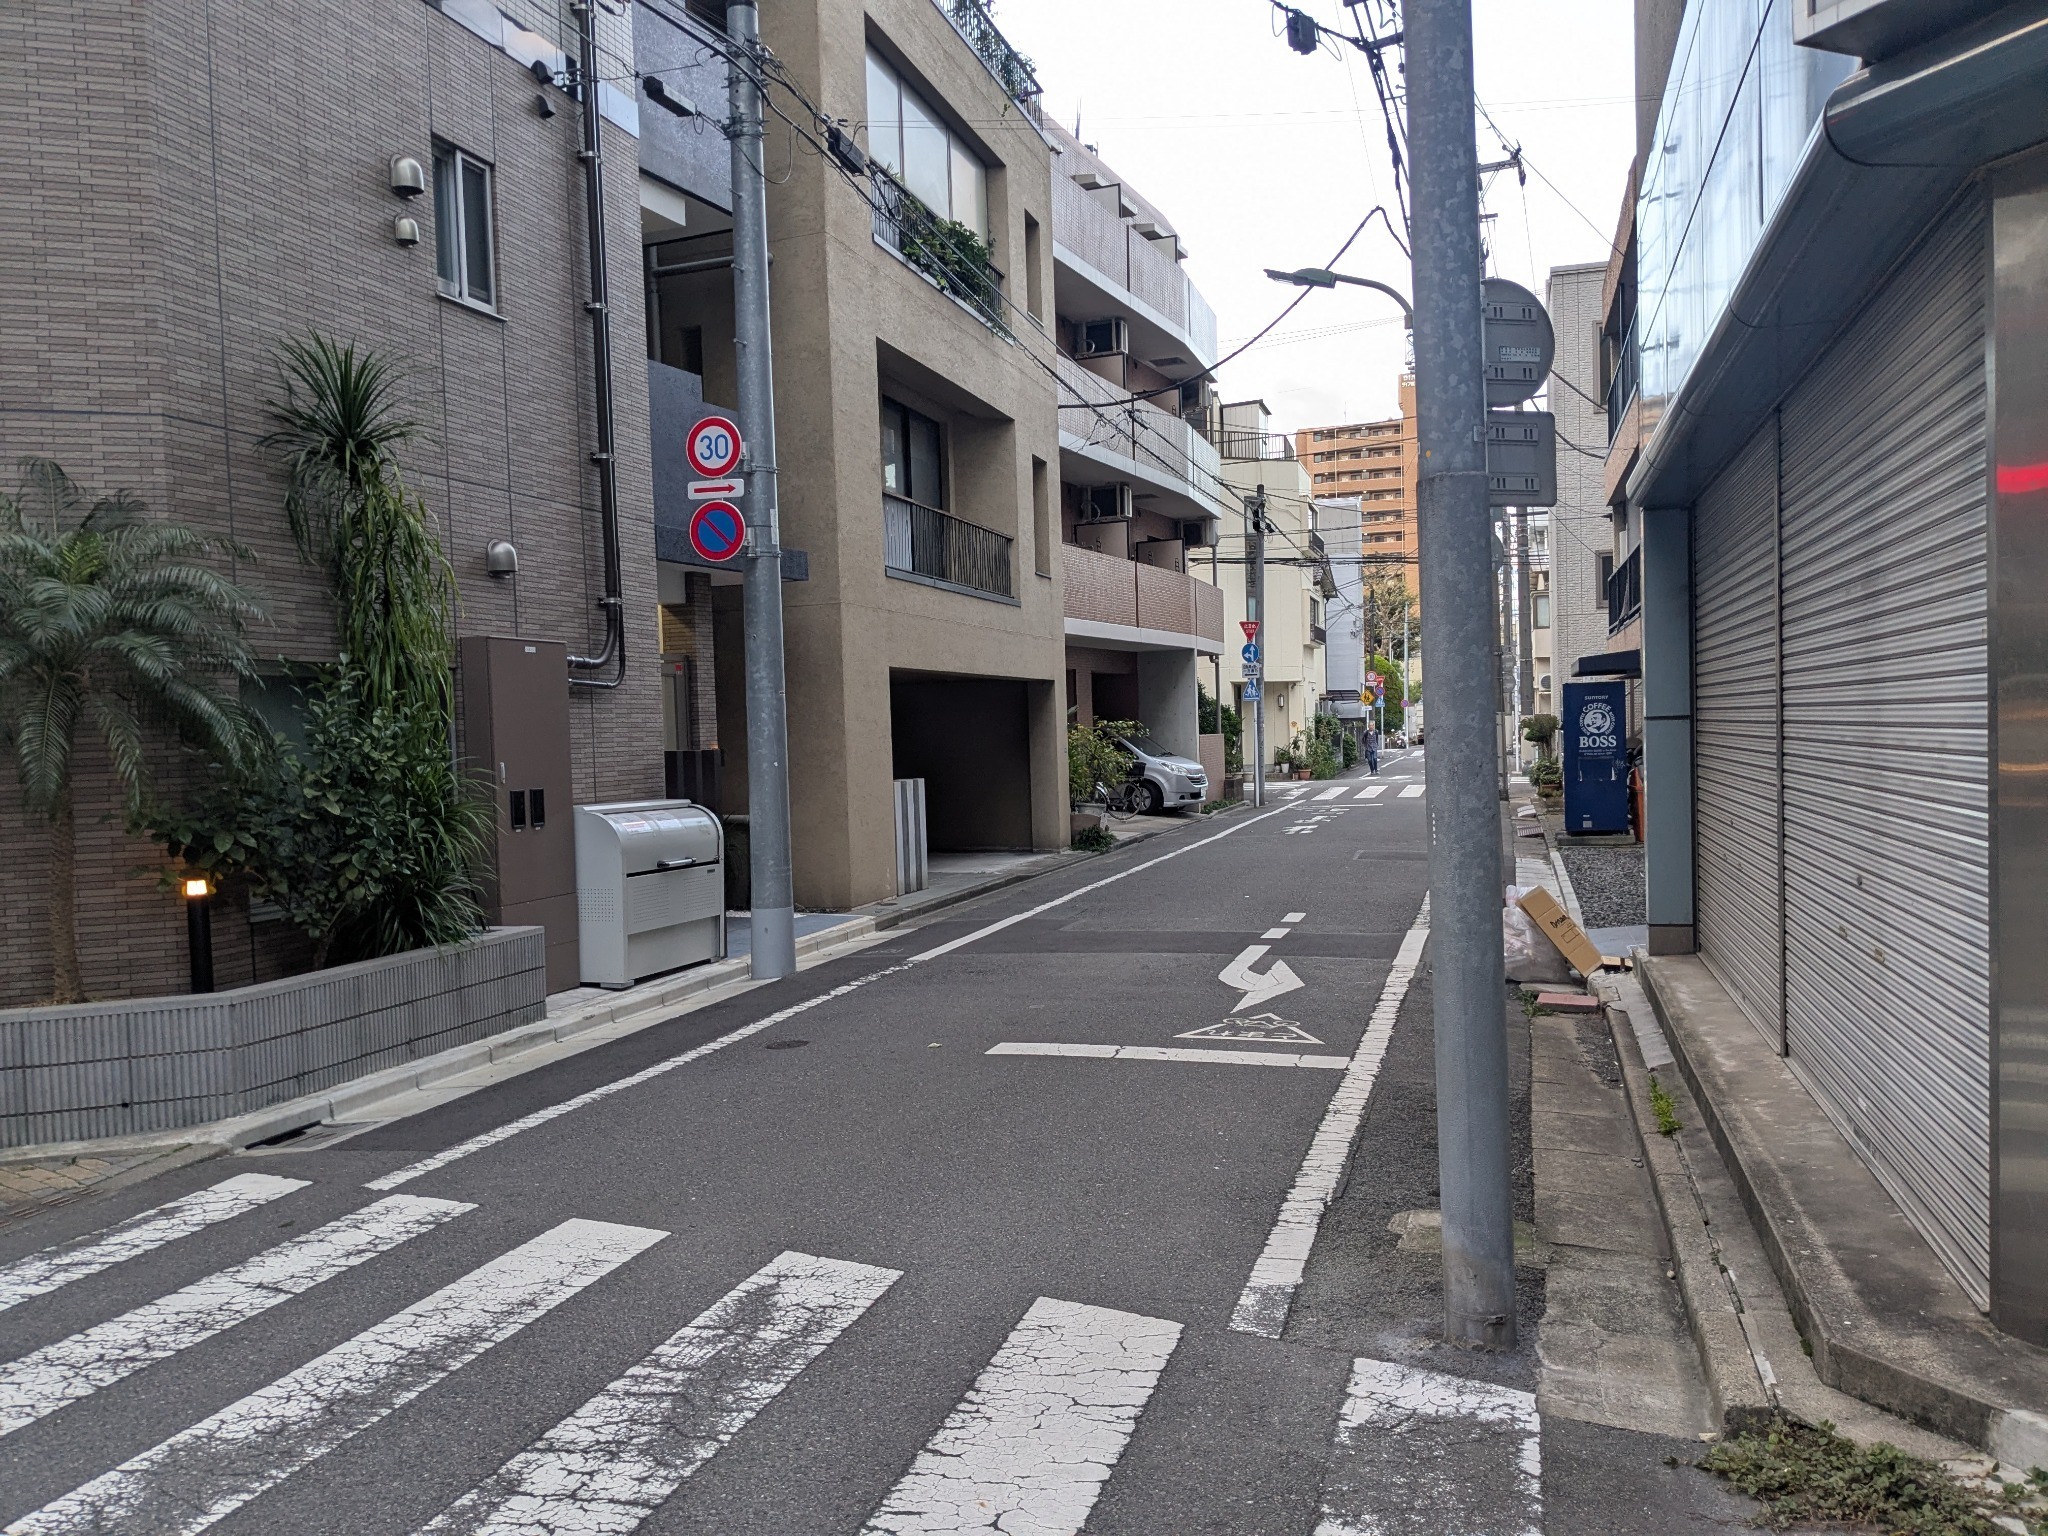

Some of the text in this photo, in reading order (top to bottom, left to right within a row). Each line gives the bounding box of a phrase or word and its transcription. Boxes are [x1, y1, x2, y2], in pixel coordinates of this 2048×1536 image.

[700, 434, 728, 460] 30
[1582, 702, 1612, 713] COFFEE
[1579, 736, 1616, 748] BOSS
